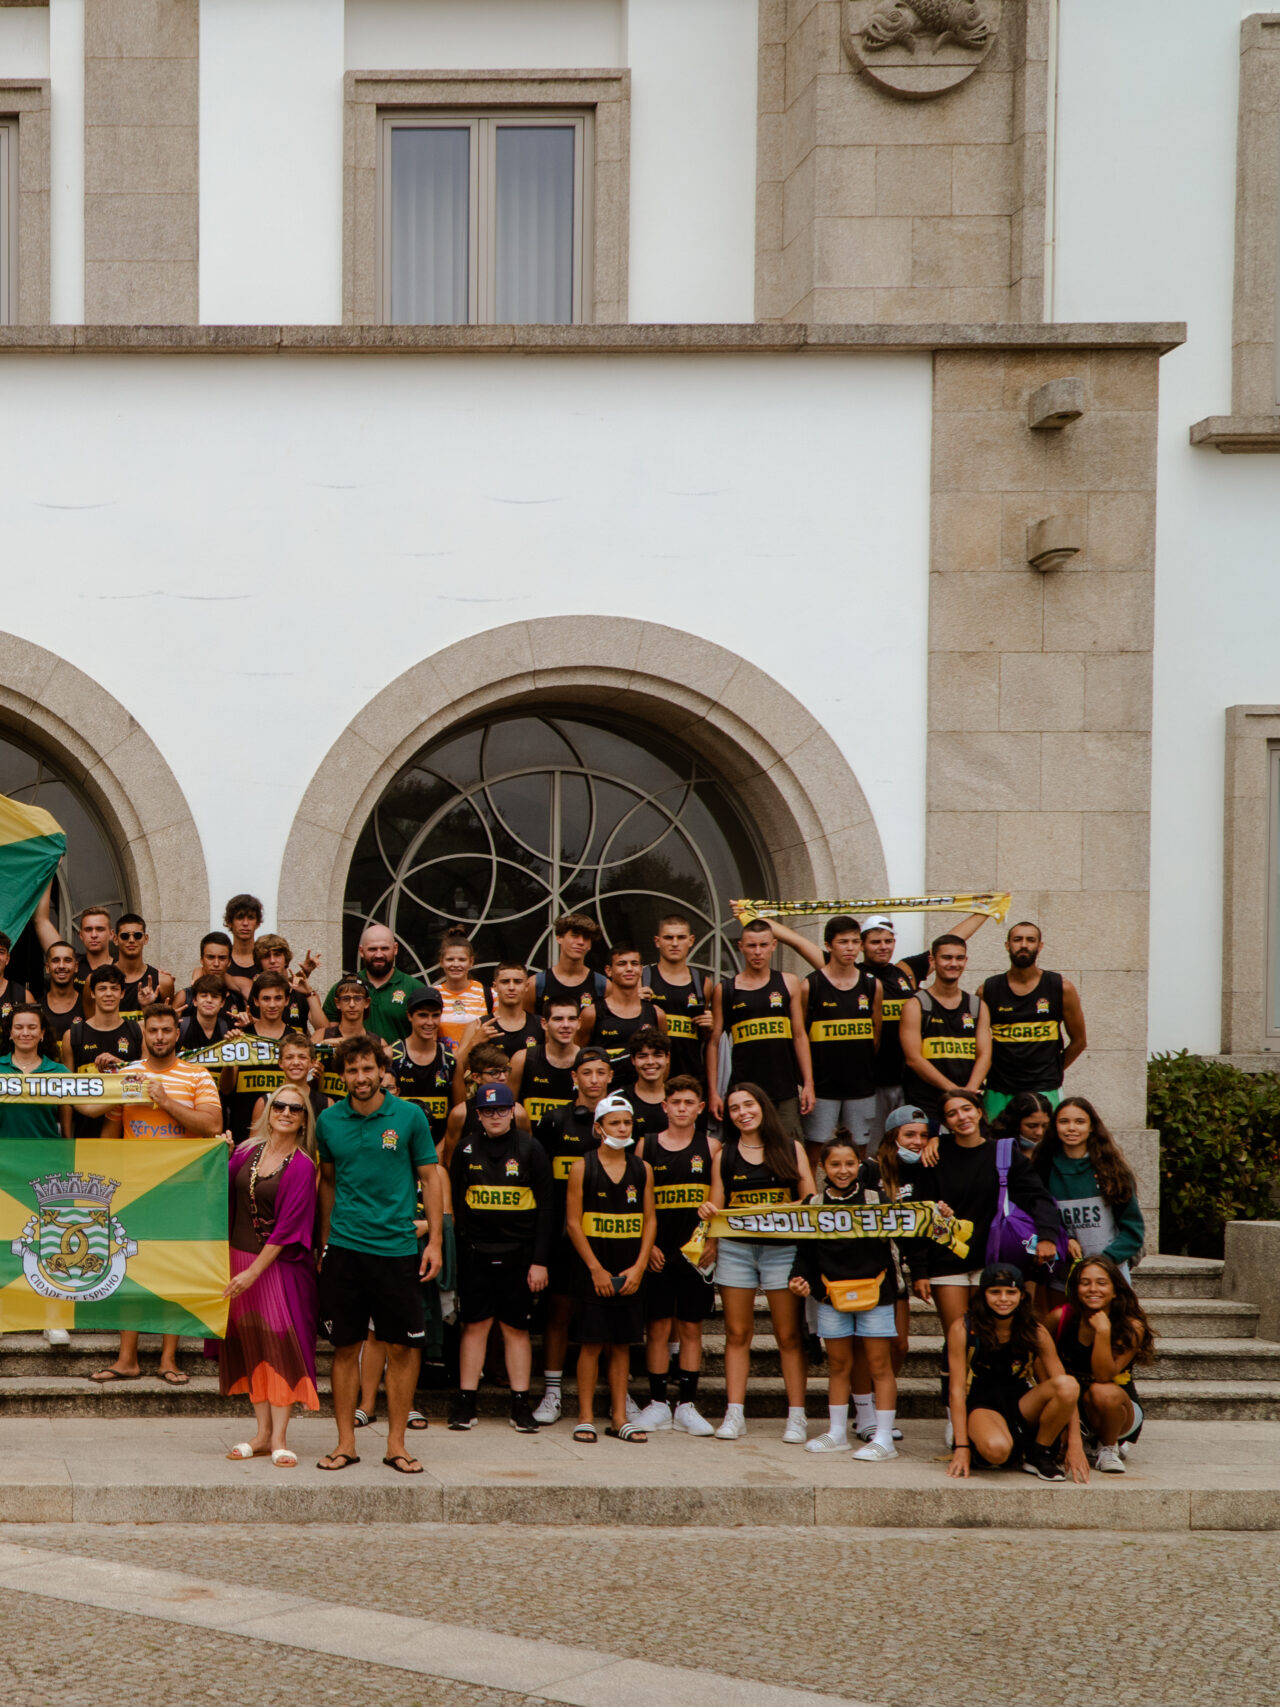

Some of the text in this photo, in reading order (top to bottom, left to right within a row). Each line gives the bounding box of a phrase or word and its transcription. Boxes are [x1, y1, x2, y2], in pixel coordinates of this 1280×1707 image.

[737, 1021, 784, 1039] TIGRES
[822, 1022, 872, 1037] TIGRES
[221, 1042, 250, 1062] OS
[930, 1041, 977, 1055] TIGRES
[25, 1077, 104, 1098] TIGRES
[243, 1075, 285, 1088] TIGRE
[471, 1190, 521, 1205] TIGRES
[654, 1188, 704, 1204] TIGRES
[736, 1191, 784, 1204] TIGRES
[727, 1209, 916, 1232] E.F.E. OS TIGRES
[1063, 1205, 1101, 1225] GRES
[593, 1217, 641, 1234] TIGRES
[30, 1274, 62, 1300] CIDADE
[83, 1274, 119, 1301] ESPINHO
